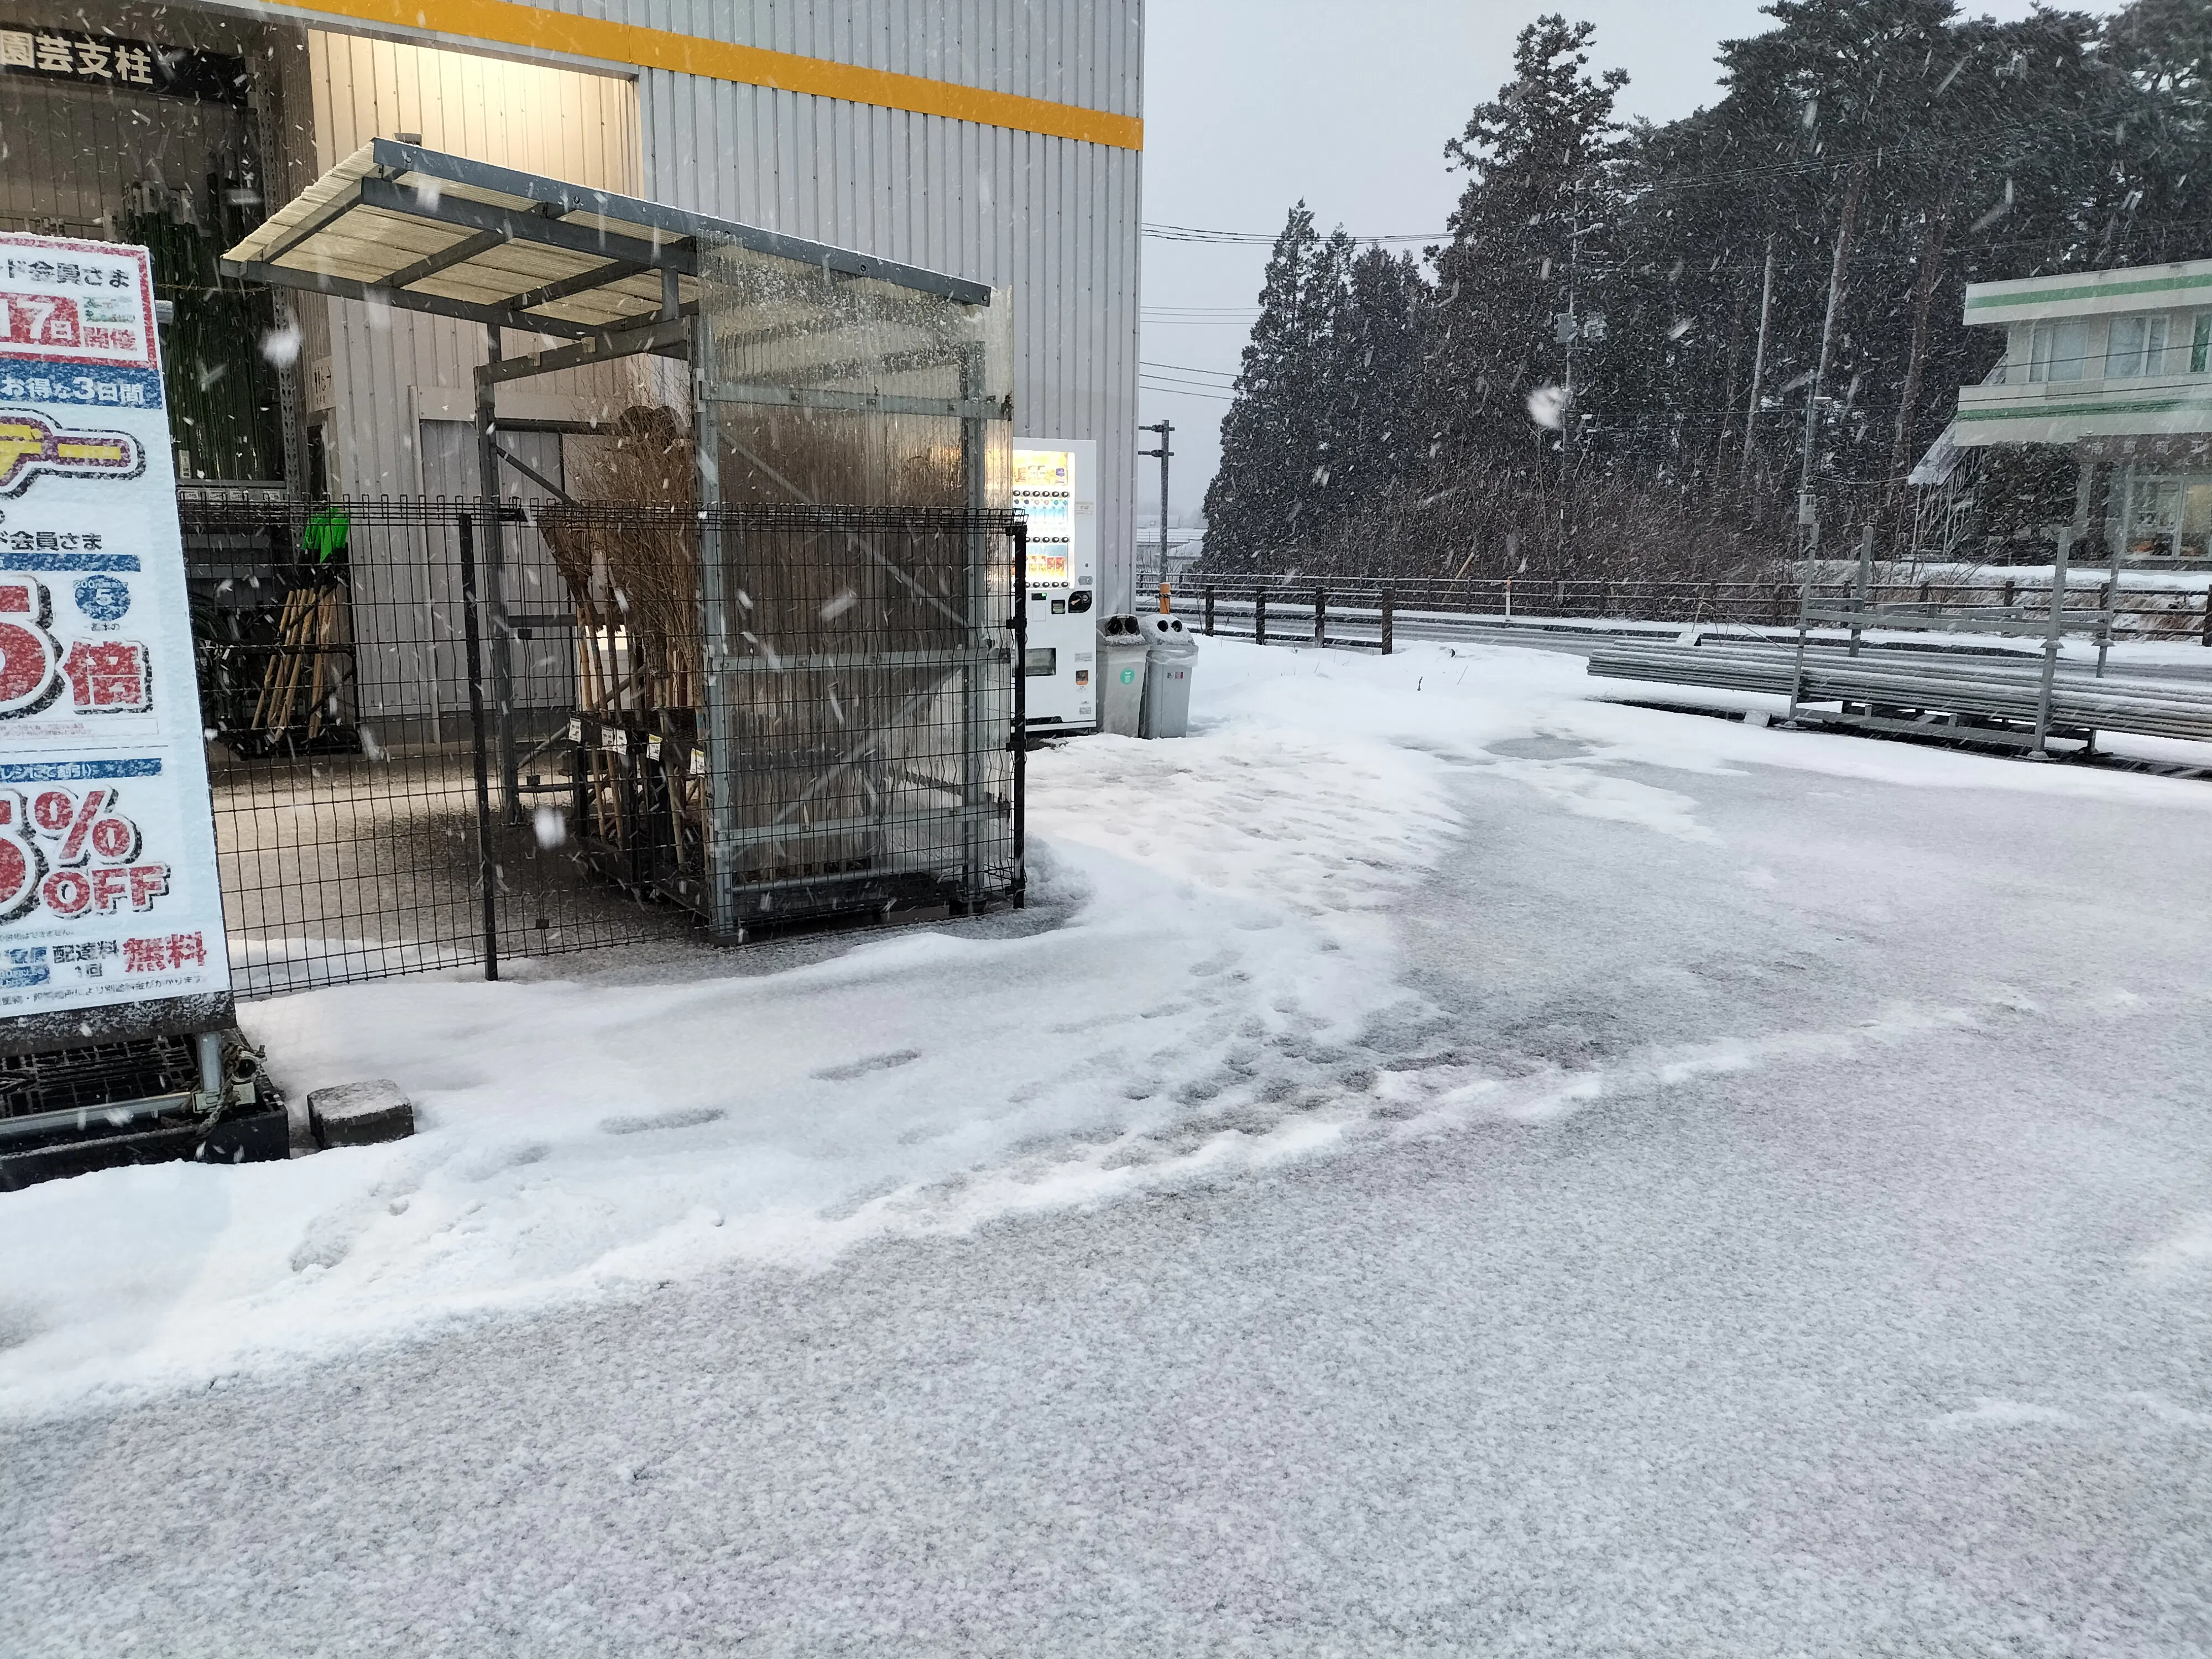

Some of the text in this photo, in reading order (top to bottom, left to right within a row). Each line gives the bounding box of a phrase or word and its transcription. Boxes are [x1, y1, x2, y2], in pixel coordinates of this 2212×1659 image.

[0, 29, 153, 85] 園芸支柱
[0, 258, 131, 288] ド会員さま
[0, 376, 145, 404] お得な3日間
[43, 865, 164, 914] OFF
[123, 931, 207, 973] 無料
